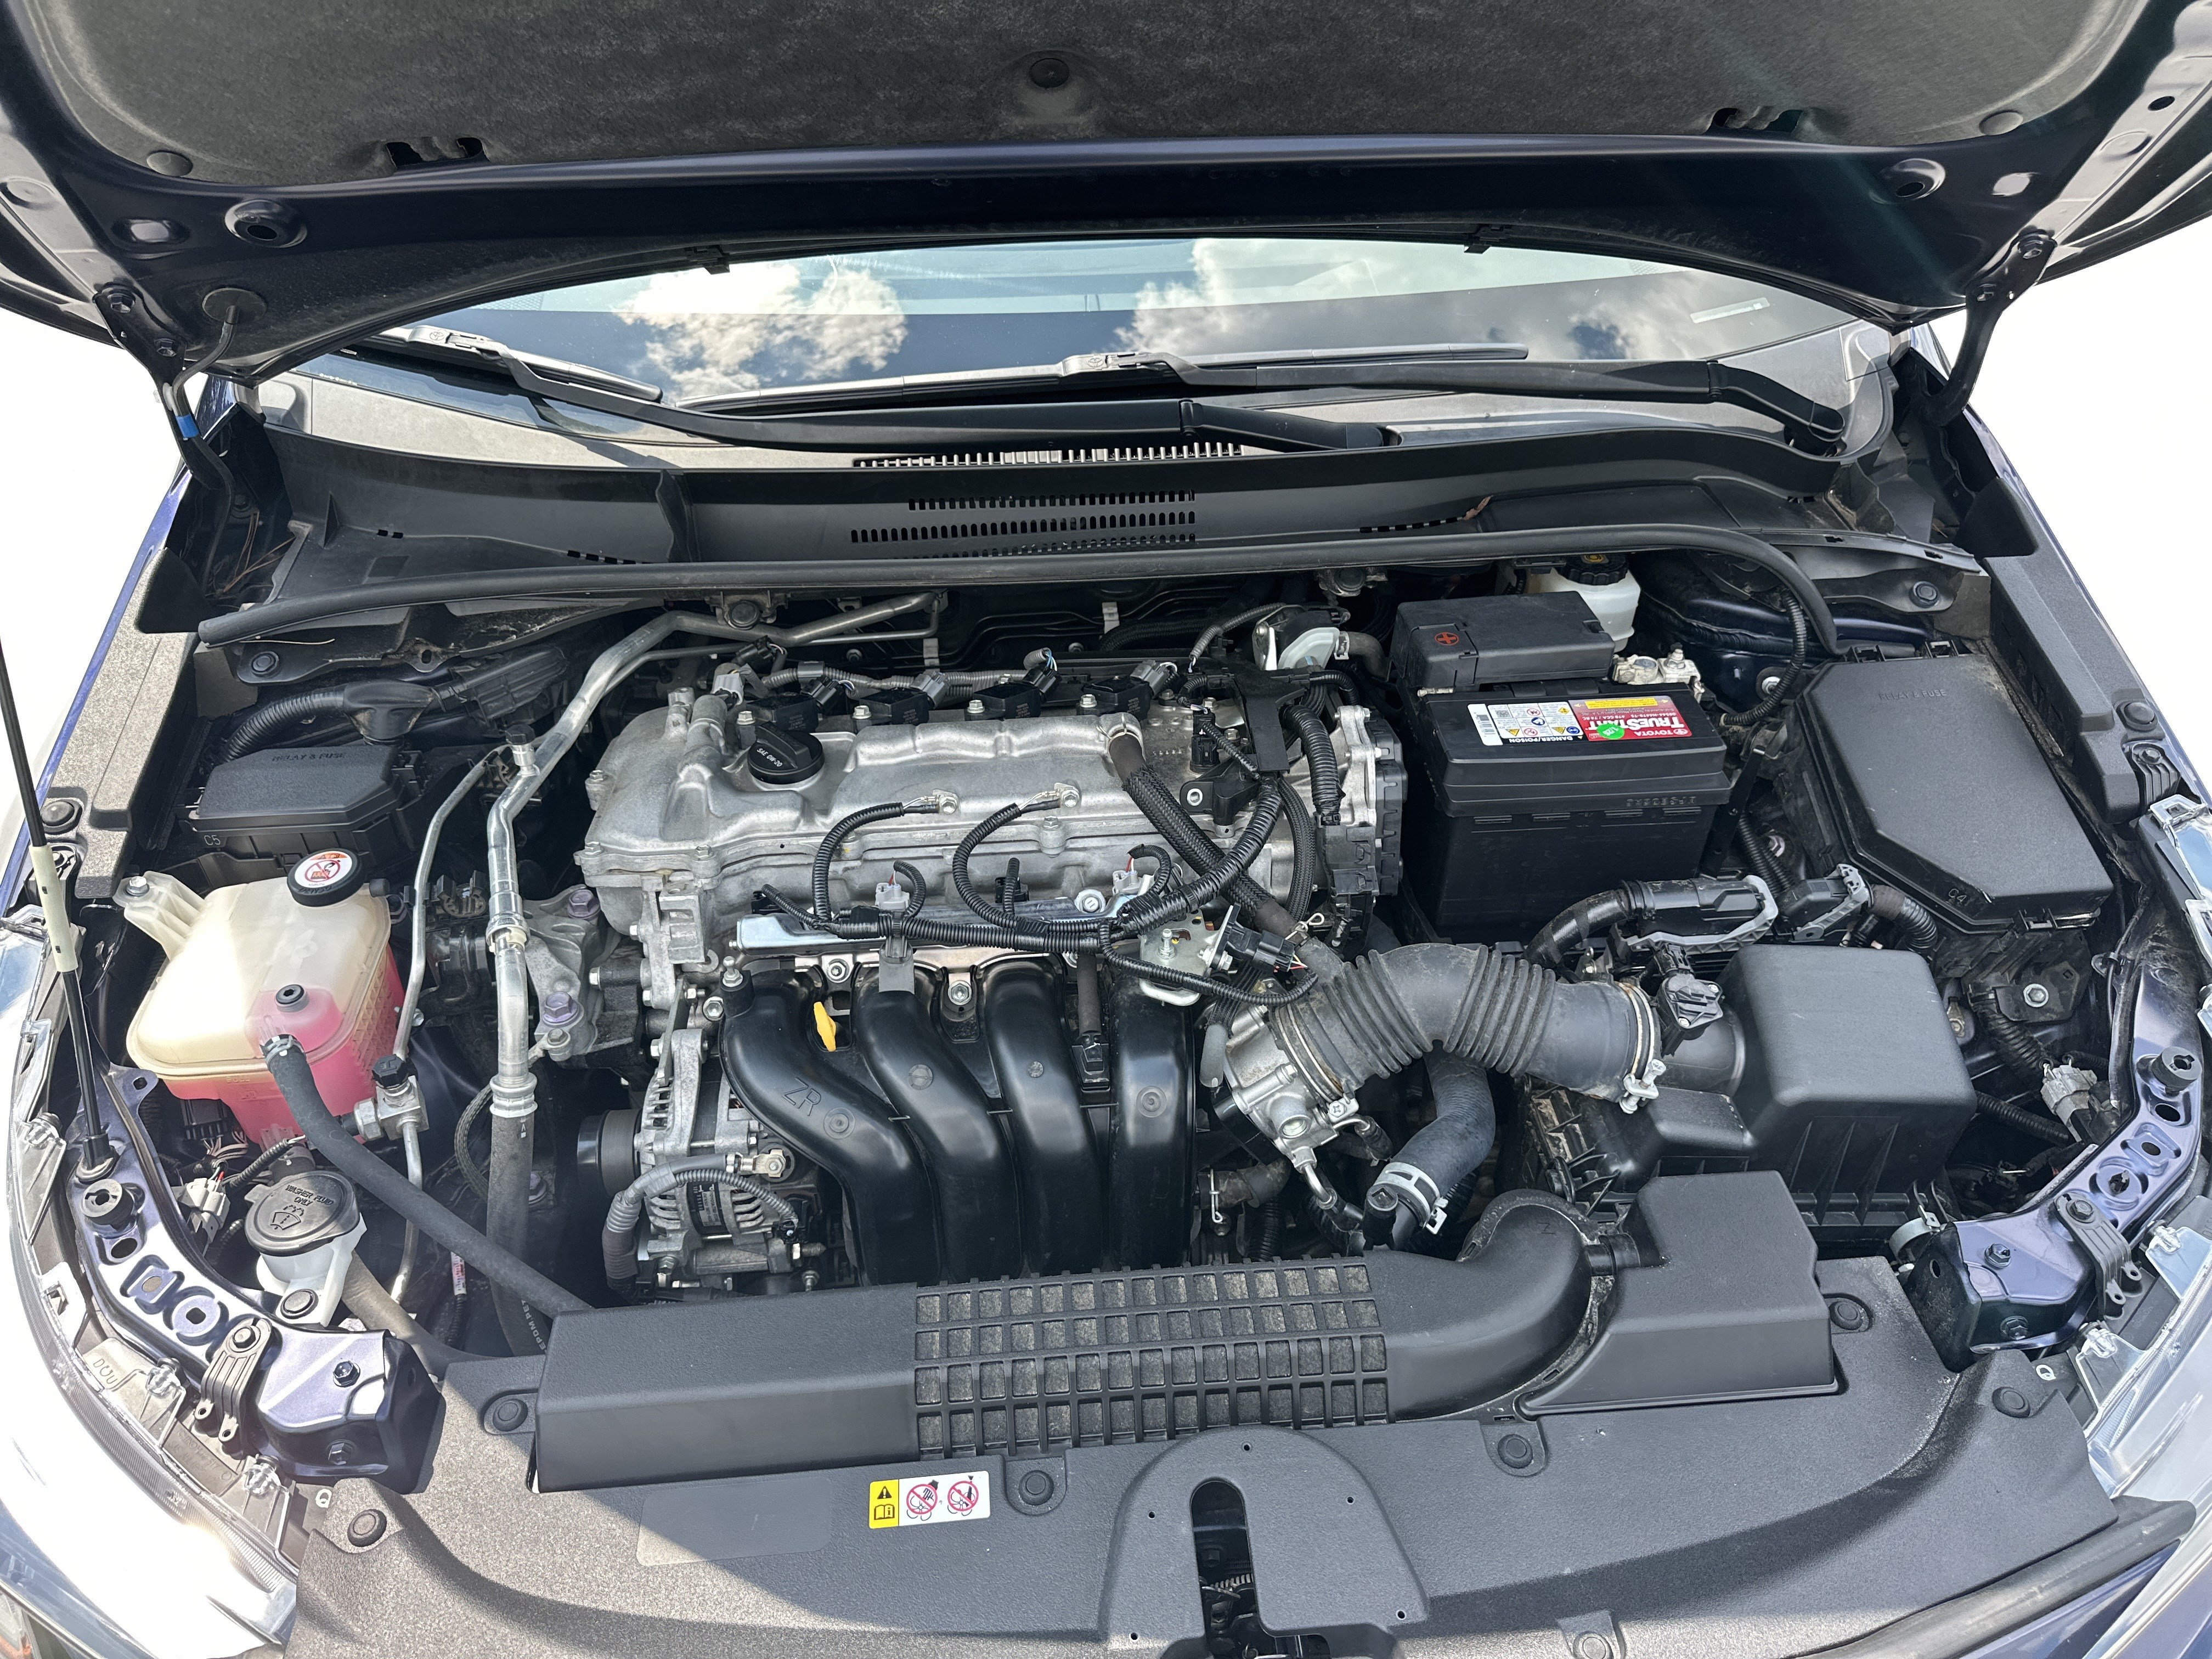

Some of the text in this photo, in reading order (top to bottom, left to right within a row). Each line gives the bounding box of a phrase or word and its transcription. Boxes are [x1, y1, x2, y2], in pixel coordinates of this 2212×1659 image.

[1921, 689, 1947, 697] FUSE
[757, 748, 783, 767] SAE 0W-20
[204, 834, 221, 845] C5
[781, 1076, 822, 1117] ZR
[285, 1184, 335, 1206] WASHER FLUID
[294, 1196, 314, 1206] ONLY
